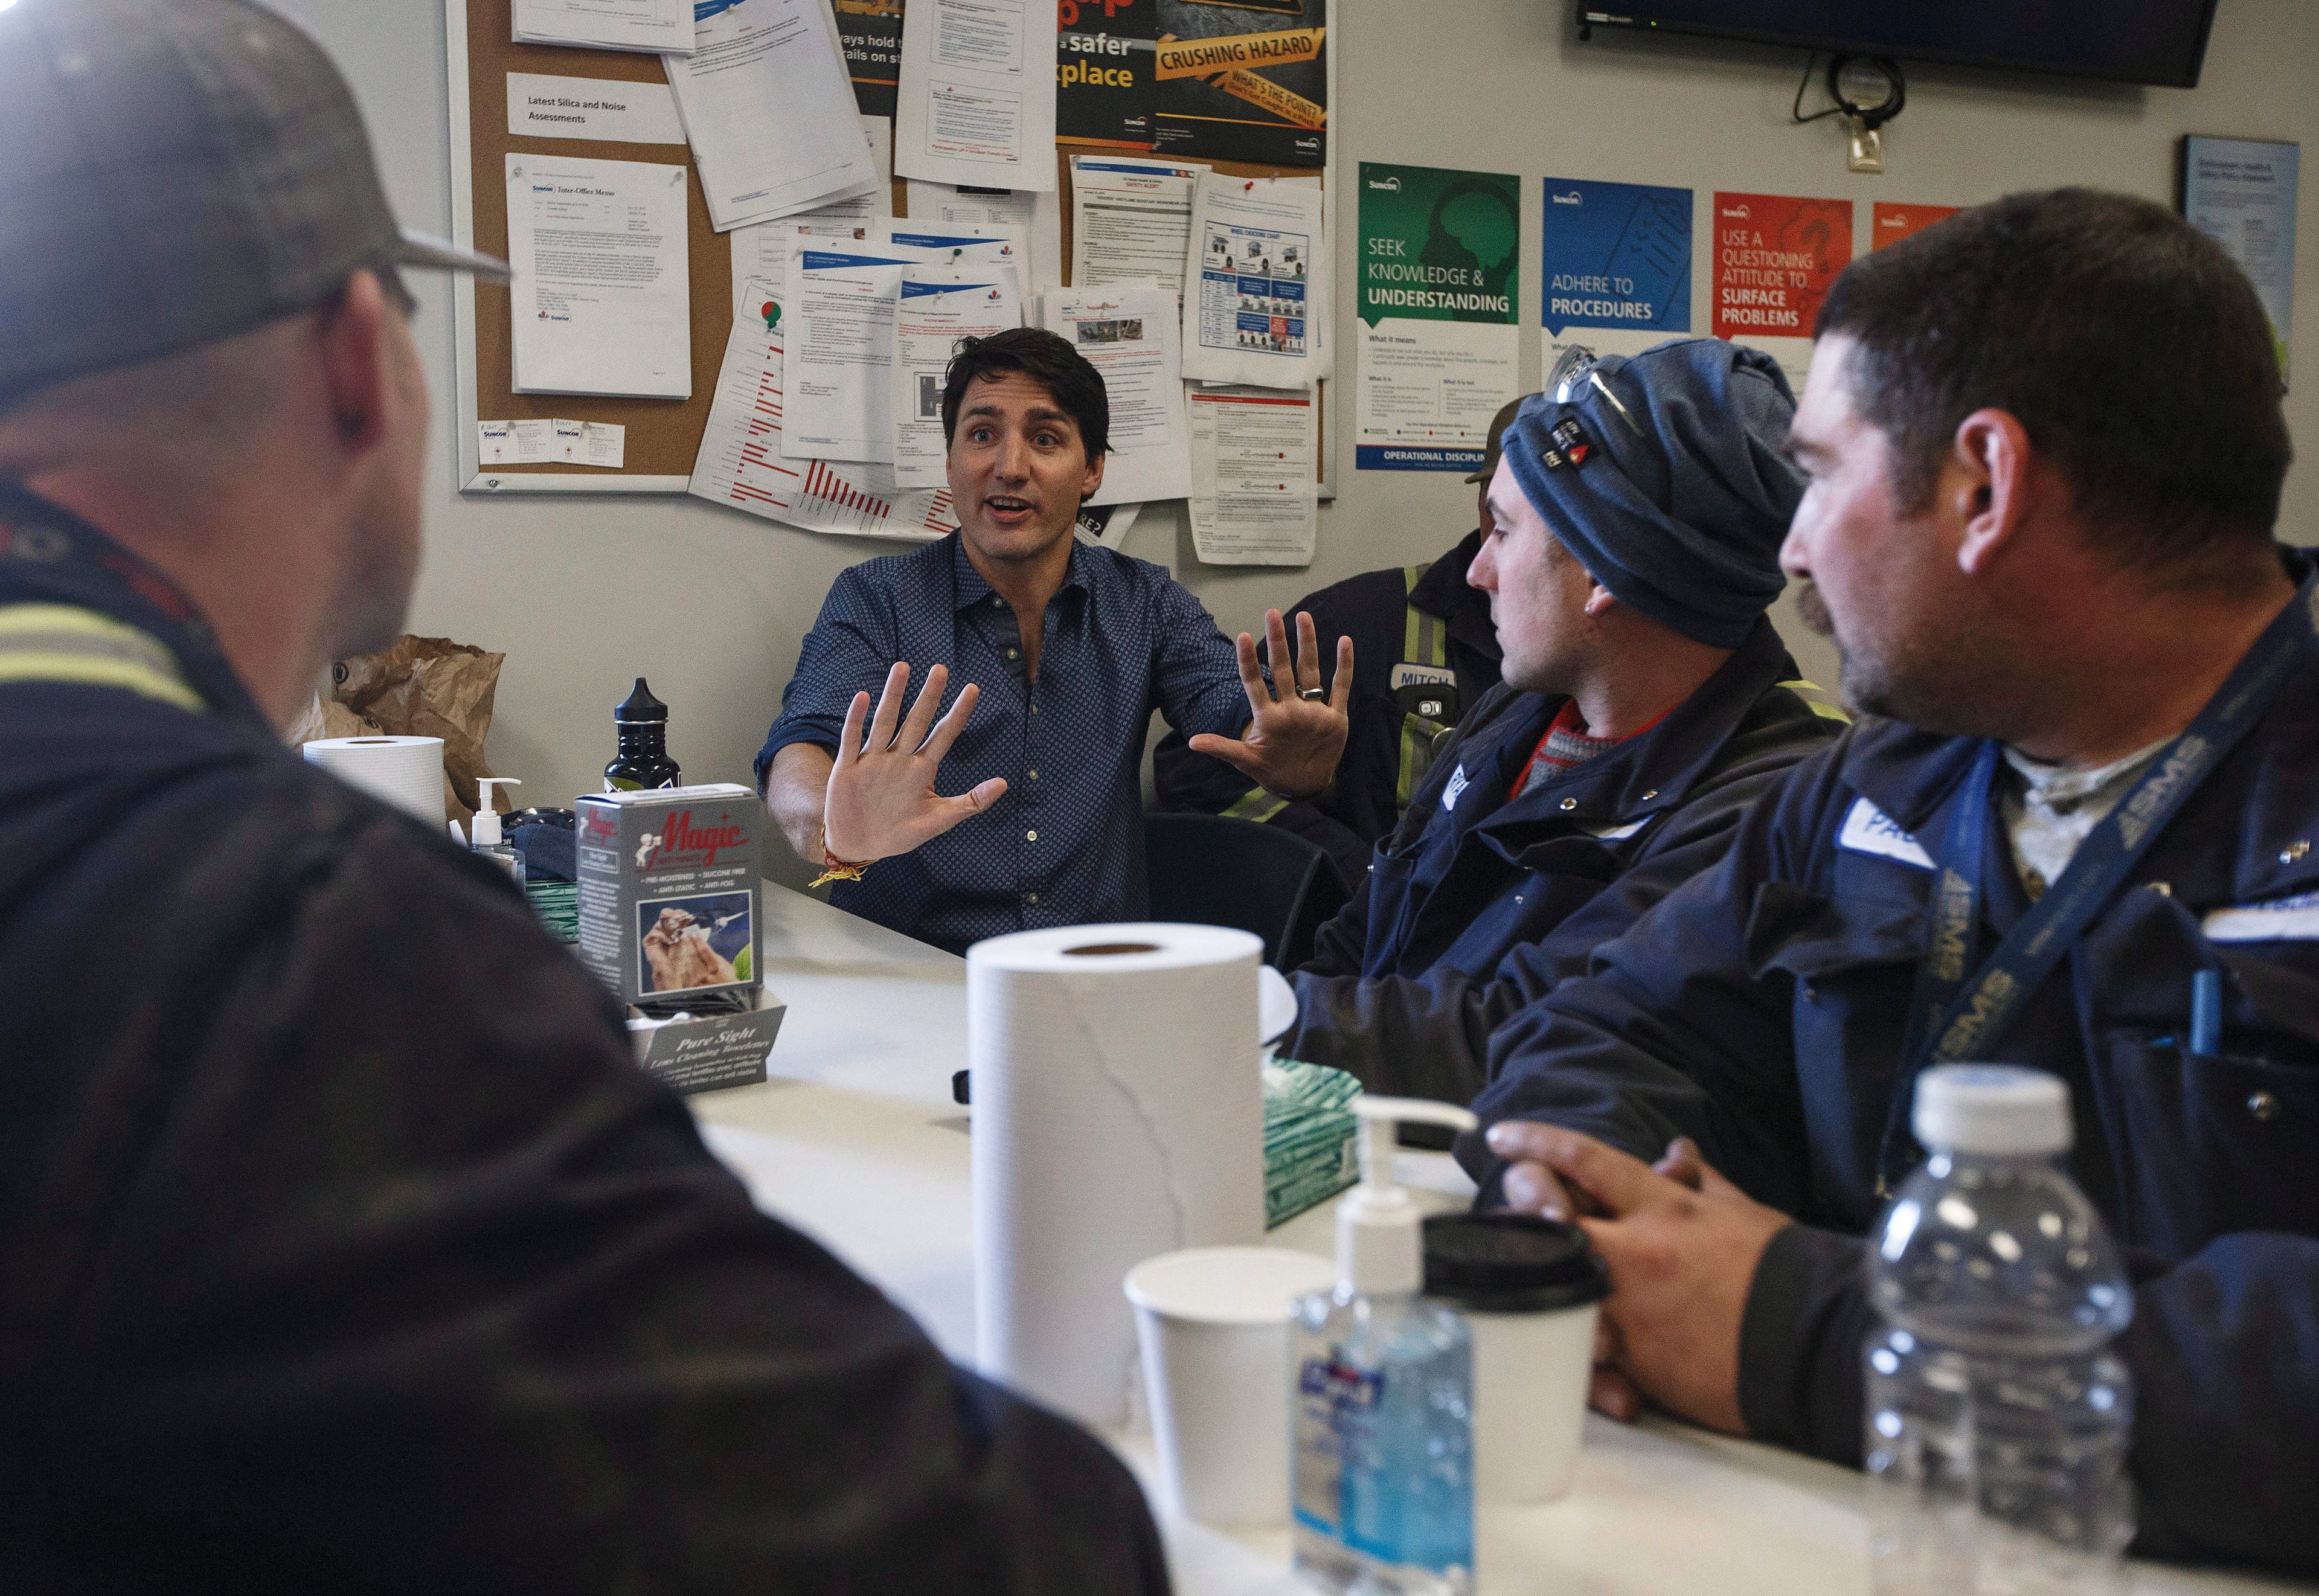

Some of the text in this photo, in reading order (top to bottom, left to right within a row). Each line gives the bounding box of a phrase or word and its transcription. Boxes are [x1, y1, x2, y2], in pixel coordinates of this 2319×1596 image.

[868, 35, 894, 48] hold
[1069, 32, 1132, 56] safer
[870, 53, 887, 63] on
[1160, 35, 1313, 71] CRUSHING HAZARD
[528, 96, 626, 111] Latest Silica and Noise
[528, 111, 586, 123] Assessments
[558, 186, 594, 195] Inter-Office
[1722, 229, 1763, 246] USE A
[1368, 238, 1406, 257] SEEK
[1722, 249, 1814, 270] QUESTIONING
[1368, 263, 1484, 287] KNOWLEDGE &
[1551, 274, 1634, 295] ADHERE TO
[1722, 269, 1807, 289] ATTITUDE TO
[1368, 288, 1510, 312] UNDERSTANDING
[1722, 288, 1786, 307] SURFACE
[1551, 298, 1652, 319] PROCEDURES
[1722, 308, 1799, 327] PROBLEMS
[1384, 450, 1443, 461] OPERATIONAL
[1401, 672, 1449, 685] MITCH
[649, 810, 751, 867] Magic
[676, 1027, 757, 1052] Pure Sight
[676, 1048, 720, 1063] Cleaning
